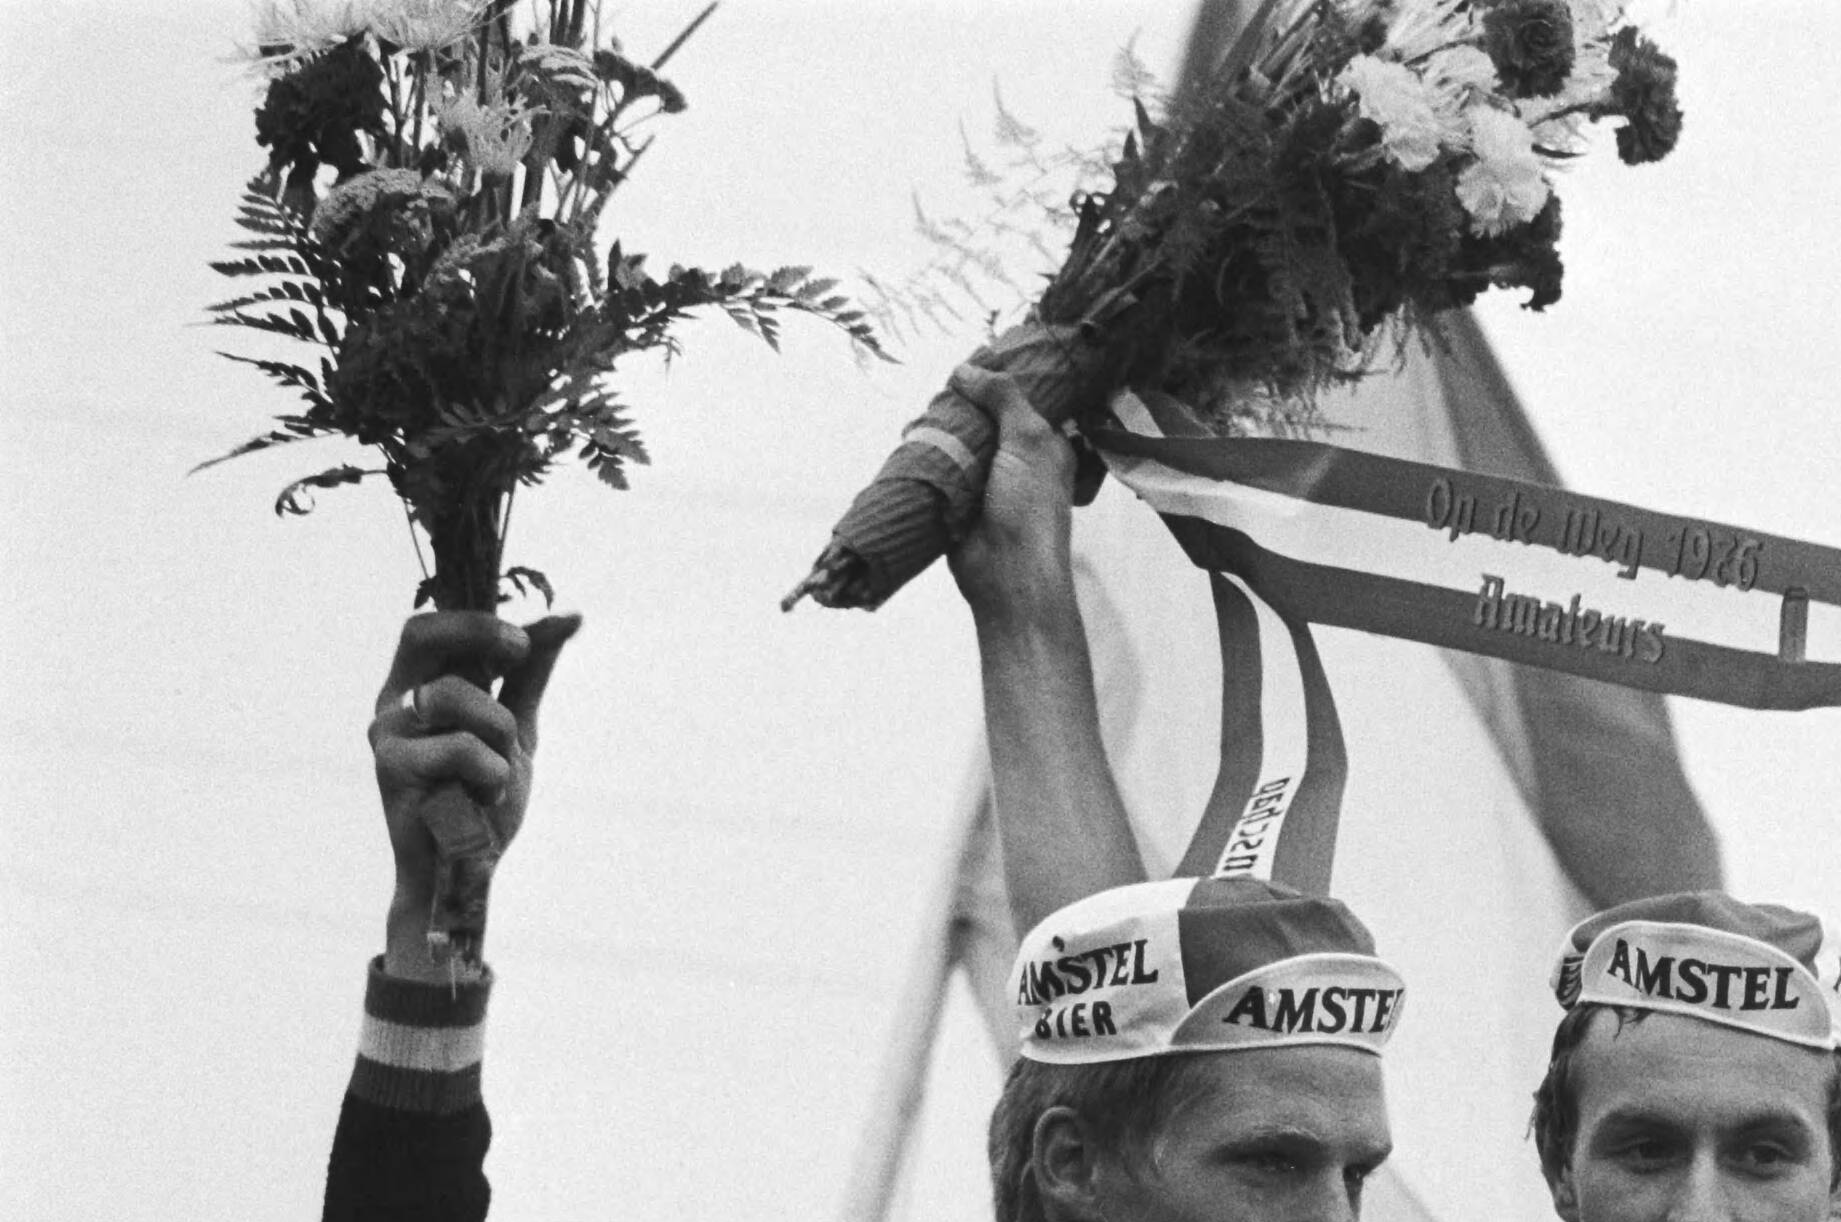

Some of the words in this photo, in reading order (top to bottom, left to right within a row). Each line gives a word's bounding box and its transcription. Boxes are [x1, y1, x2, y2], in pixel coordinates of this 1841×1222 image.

[1426, 477, 1475, 543] Op
[1497, 491, 1541, 545] de
[1562, 508, 1645, 580] Weg
[1475, 573, 1666, 663] Amateurs
[1018, 939, 1159, 1006] AMSTEL
[1607, 938, 1799, 1011] AMSTEL
[1222, 986, 1404, 1034] AMSTE
